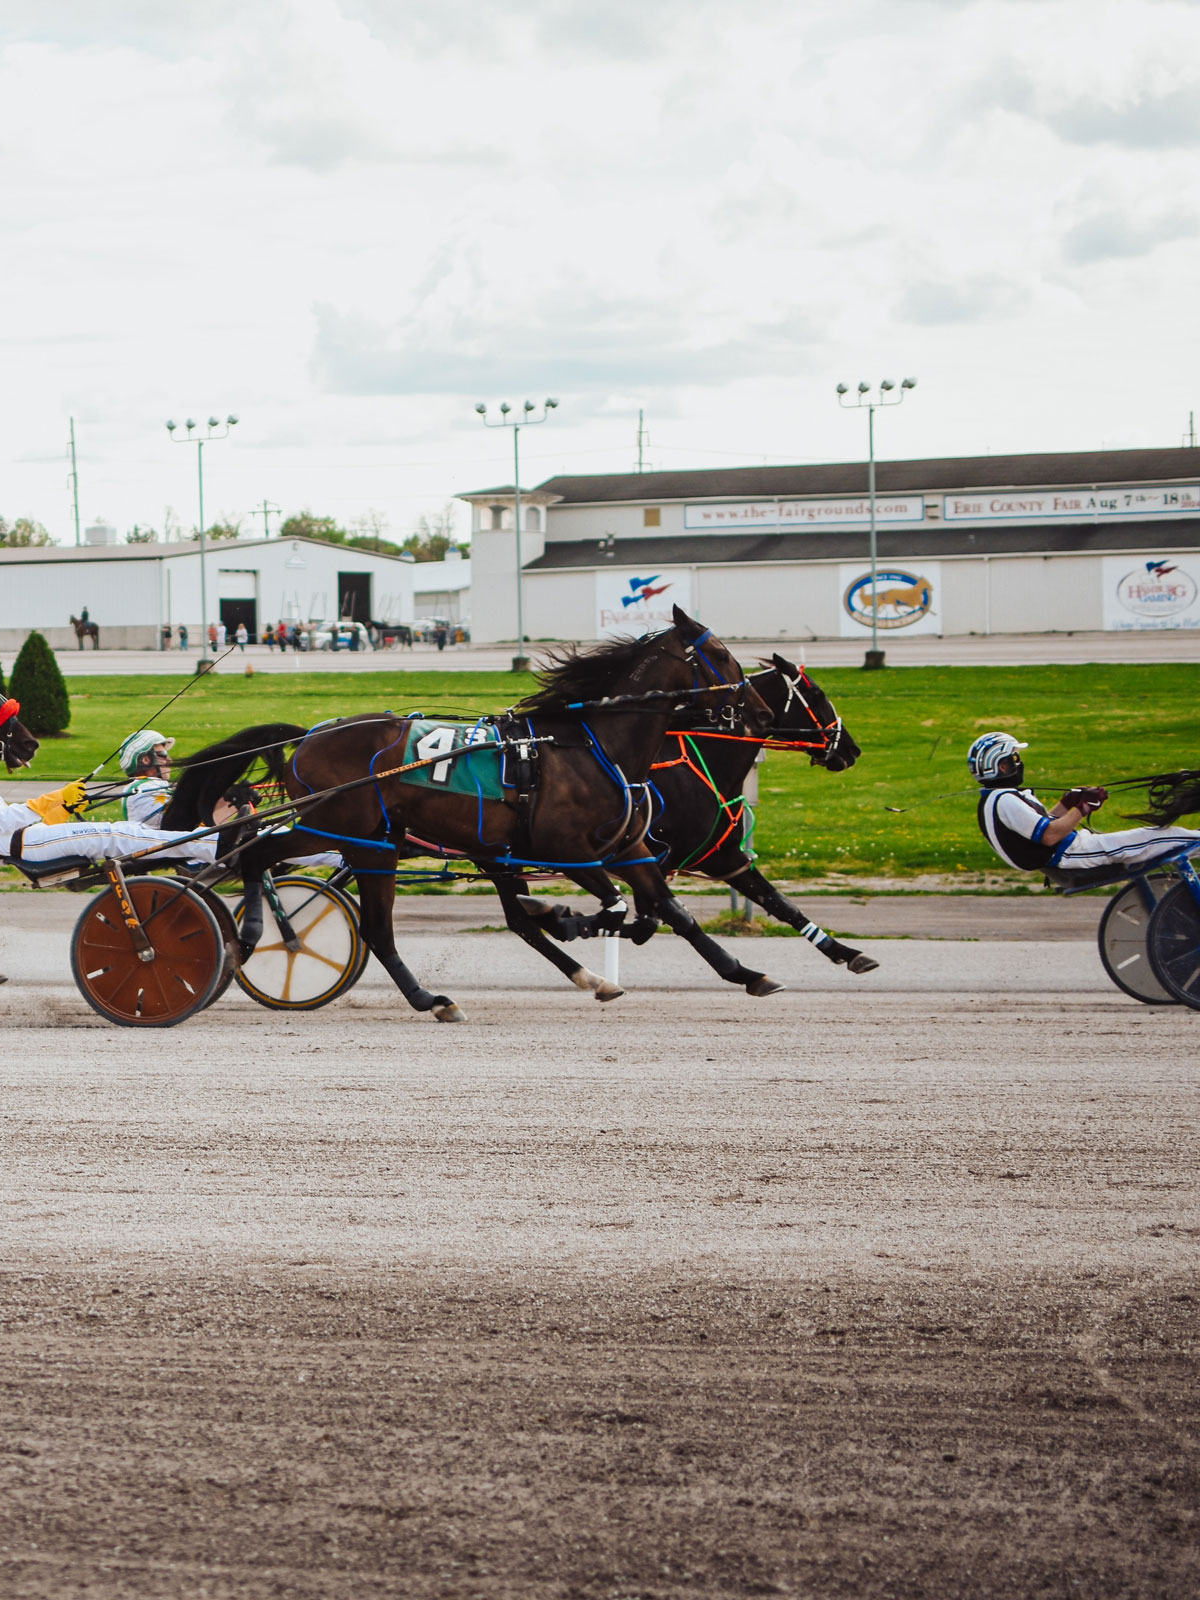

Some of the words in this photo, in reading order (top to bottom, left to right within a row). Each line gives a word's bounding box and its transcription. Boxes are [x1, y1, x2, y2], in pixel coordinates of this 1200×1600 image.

[702, 500, 908, 520] www.the-fairgroundscom
[1086, 496, 1118, 510] Aug
[414, 726, 458, 785] 4
